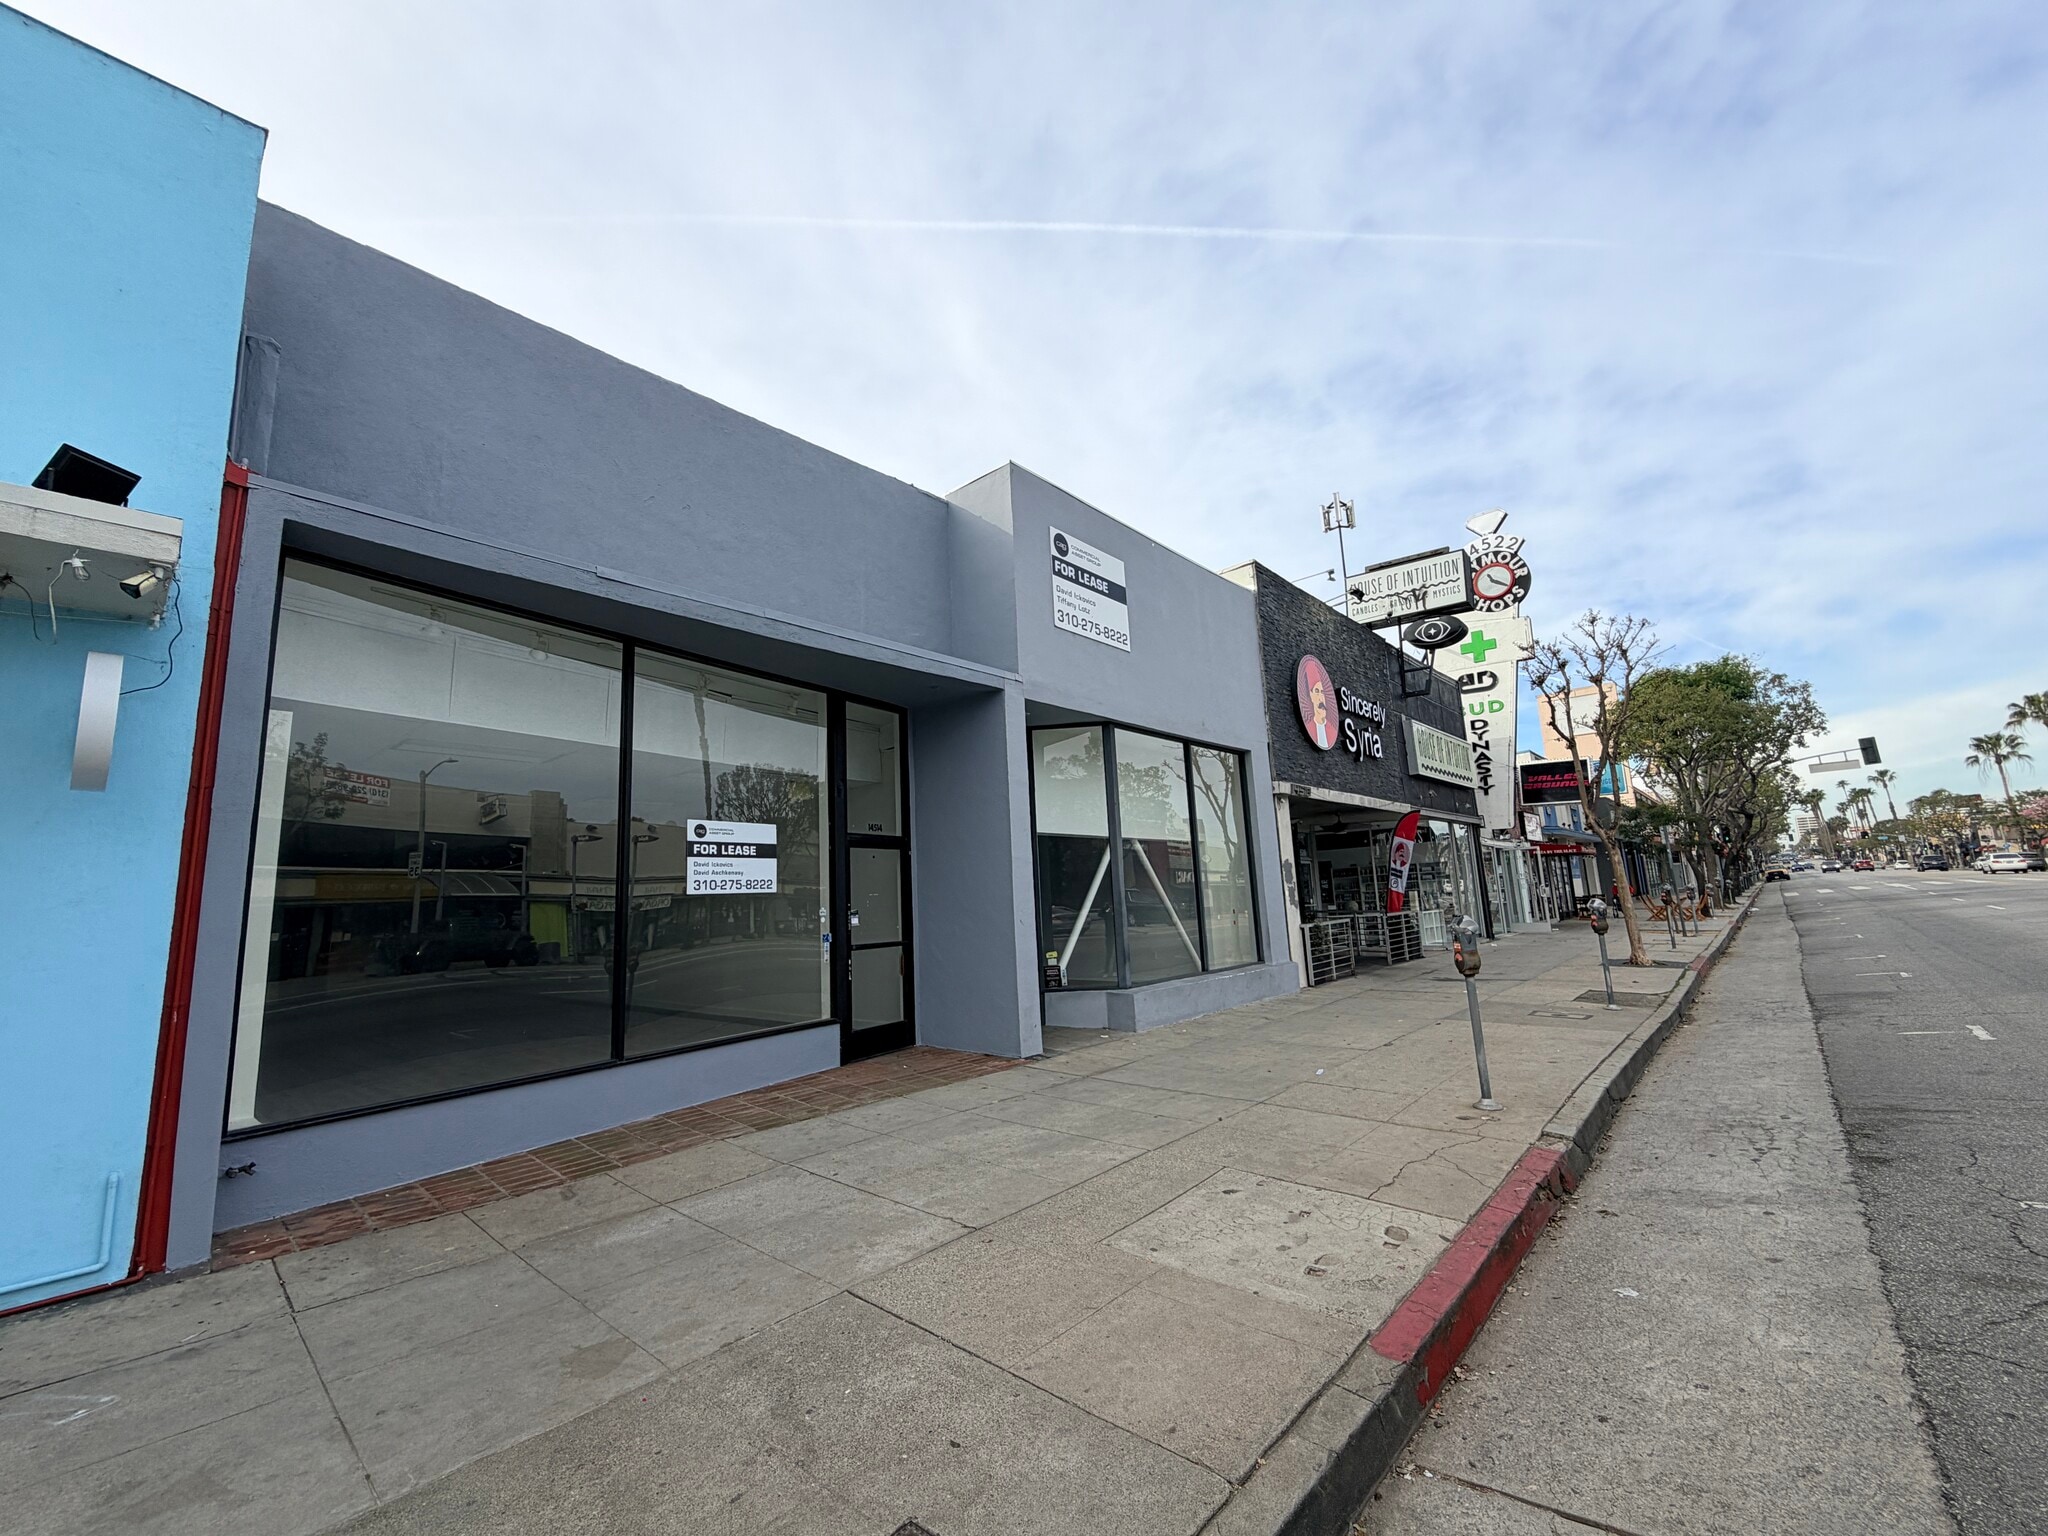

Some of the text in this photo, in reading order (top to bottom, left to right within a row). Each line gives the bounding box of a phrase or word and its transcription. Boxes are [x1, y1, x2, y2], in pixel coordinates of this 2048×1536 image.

[1469, 535, 1519, 556] 4522
[1054, 560, 1109, 593] FOR LEASE
[1387, 572, 1399, 591] OF
[1402, 558, 1459, 587] INTUITION
[1471, 552, 1529, 579] YMOUR
[1056, 584, 1097, 607] David Ickovics
[1056, 595, 1091, 615] Tiffany Lotz
[1351, 603, 1379, 617] CANDLES
[1432, 585, 1461, 599] MYSTICS
[1057, 609, 1129, 646] 310-275-8222
[1340, 686, 1386, 729] Sincerely
[1462, 699, 1505, 716] UD
[1344, 717, 1383, 762] Syria
[1470, 719, 1496, 796] DYNASTY
[693, 844, 757, 856] FOR LEASE
[693, 879, 774, 891] 310-275-8222
[711, 869, 744, 877] Aschkenasy
